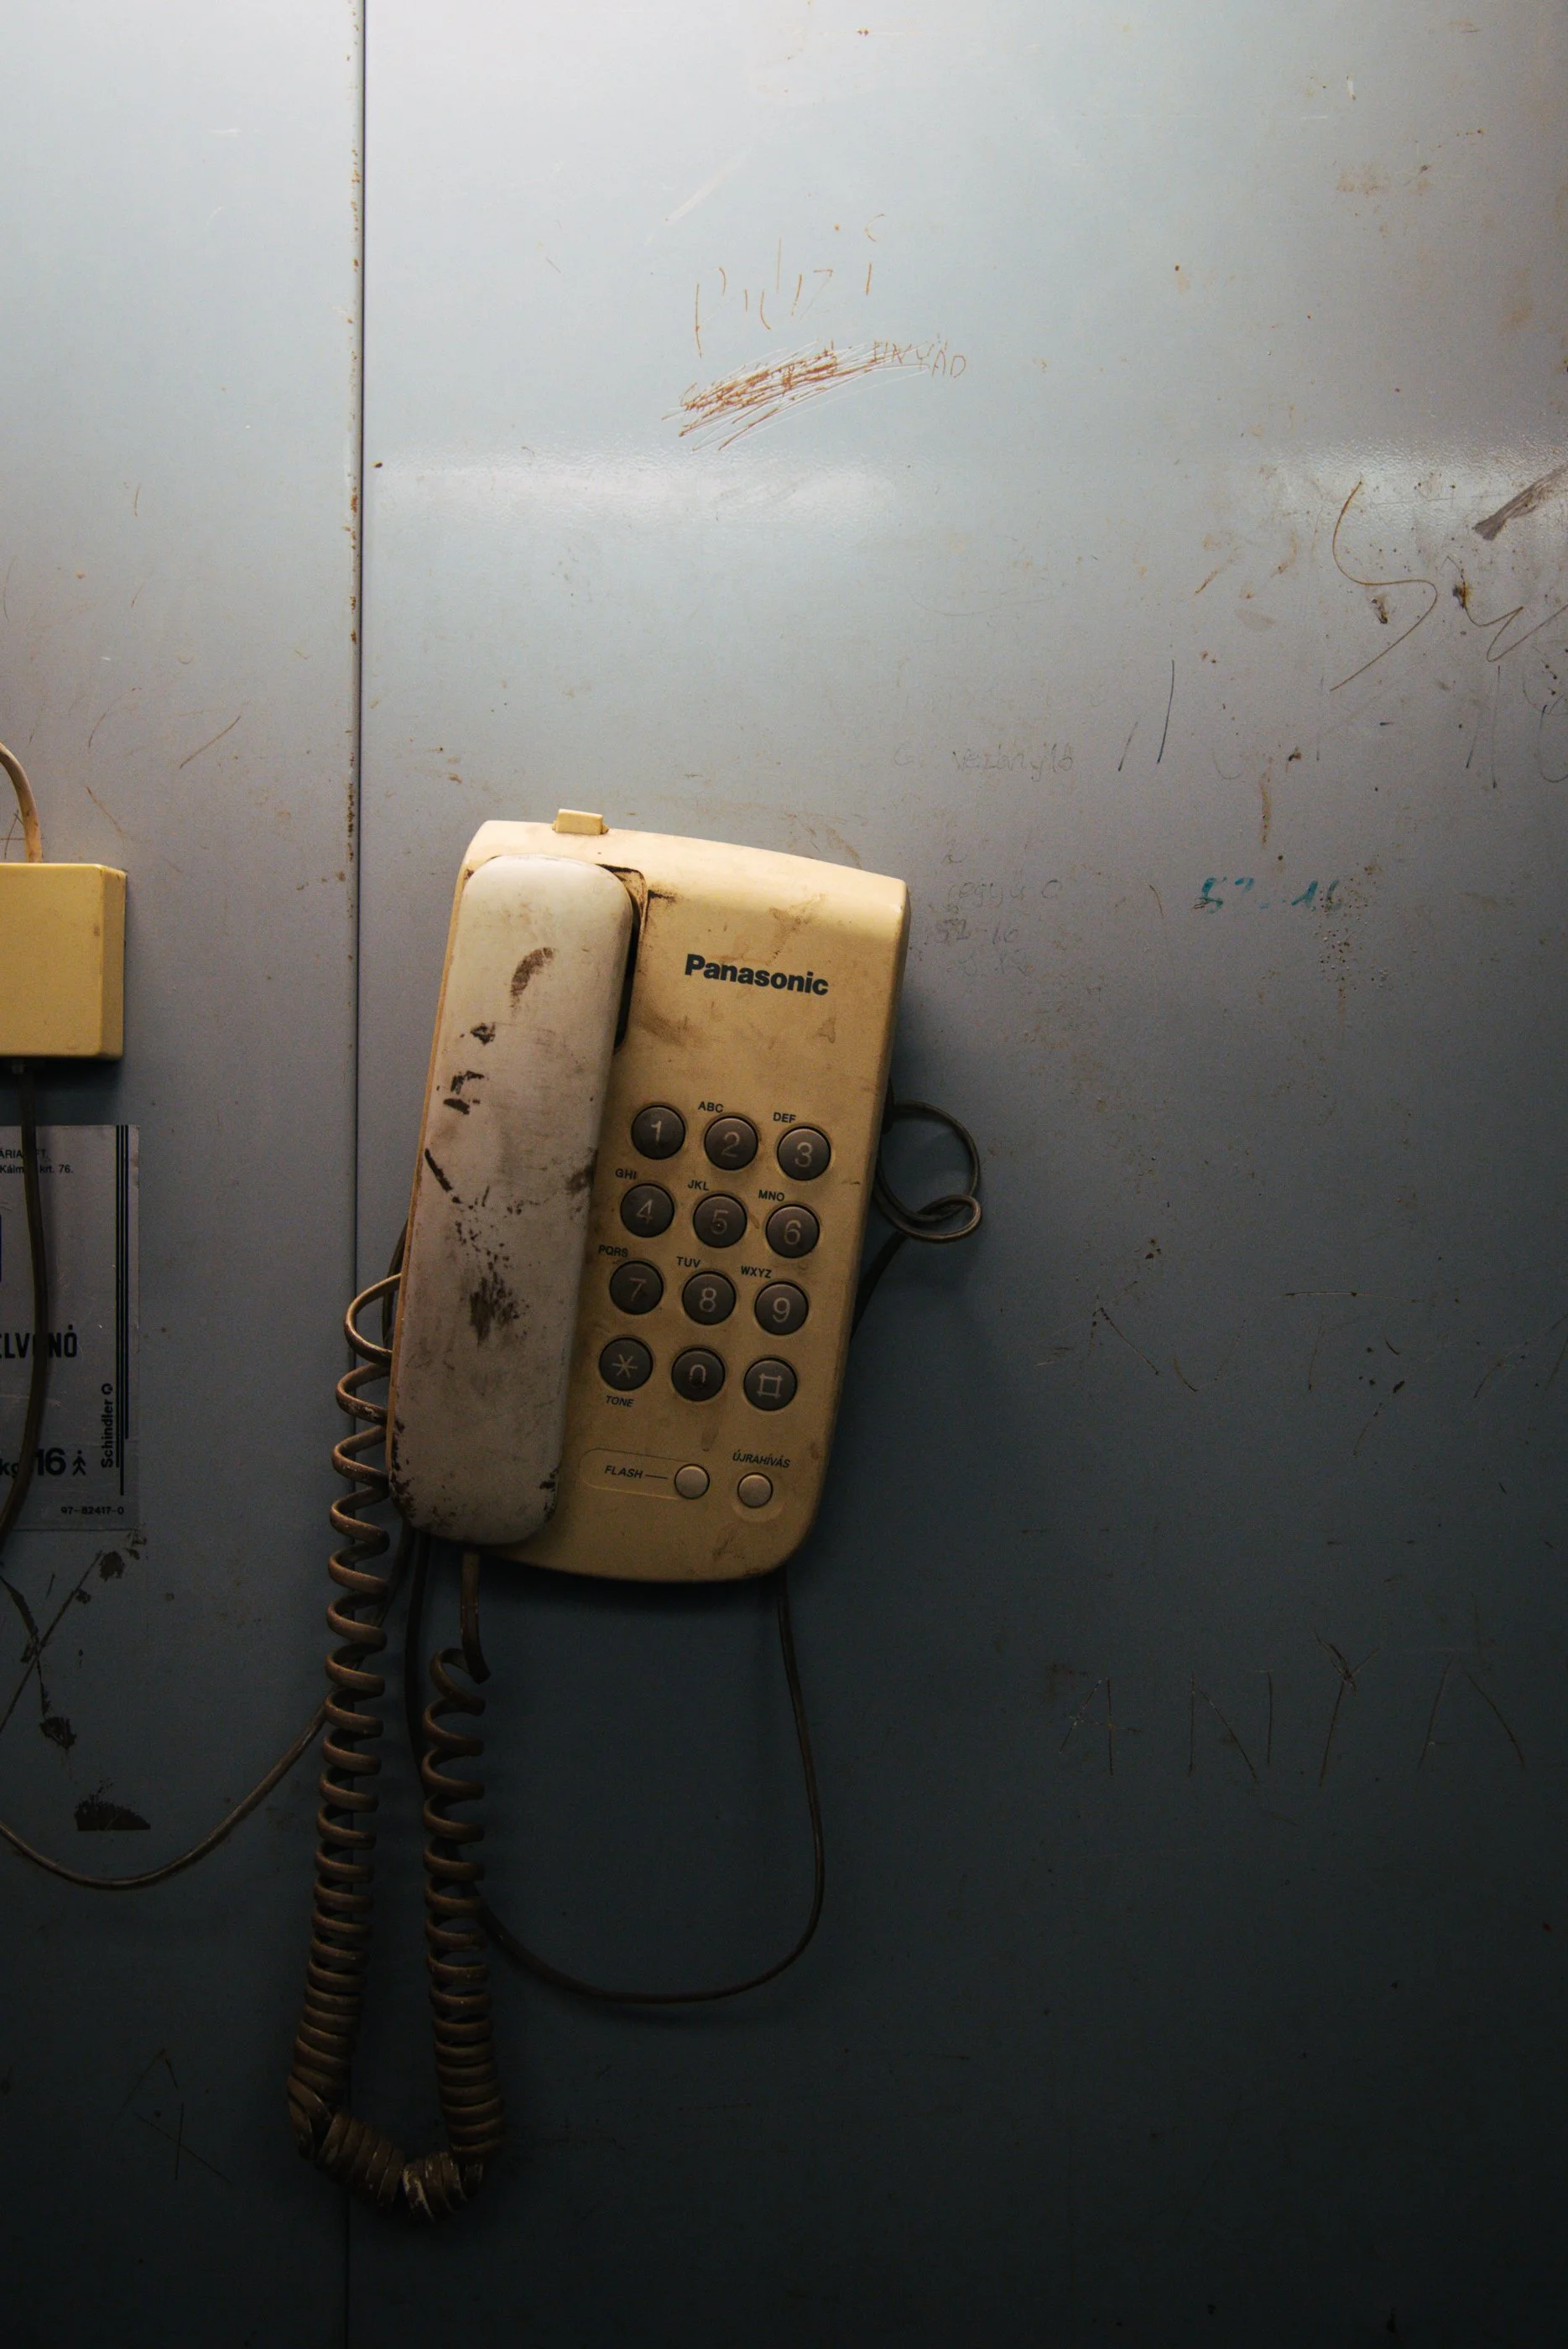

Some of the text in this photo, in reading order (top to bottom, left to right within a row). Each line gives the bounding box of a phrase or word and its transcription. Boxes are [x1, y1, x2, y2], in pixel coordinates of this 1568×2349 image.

[685, 953, 829, 996] Panasonic
[698, 1101, 724, 1113] ABC
[773, 1112, 796, 1124] DEF
[650, 1120, 662, 1146] 1
[721, 1131, 740, 1159] 2
[794, 1141, 814, 1168] 3
[615, 1168, 638, 1180] GHI
[688, 1180, 710, 1191] JKL
[758, 1190, 785, 1202] MNO
[636, 1199, 654, 1223] 4
[711, 1209, 729, 1236] 5
[784, 1219, 802, 1246] 6
[598, 1245, 628, 1258] PQRS
[676, 1256, 701, 1268] TUV
[741, 1265, 773, 1279] WXYZ
[629, 1276, 647, 1302] 7
[699, 1287, 717, 1313] 8
[773, 1297, 791, 1323] 9
[606, 1395, 634, 1408] TONE
[101, 1398, 113, 1468] Schindler
[35, 1447, 66, 1476] 16
[732, 1450, 791, 1469] ÚJRAHÍVÁS
[604, 1465, 643, 1479] FLASH
